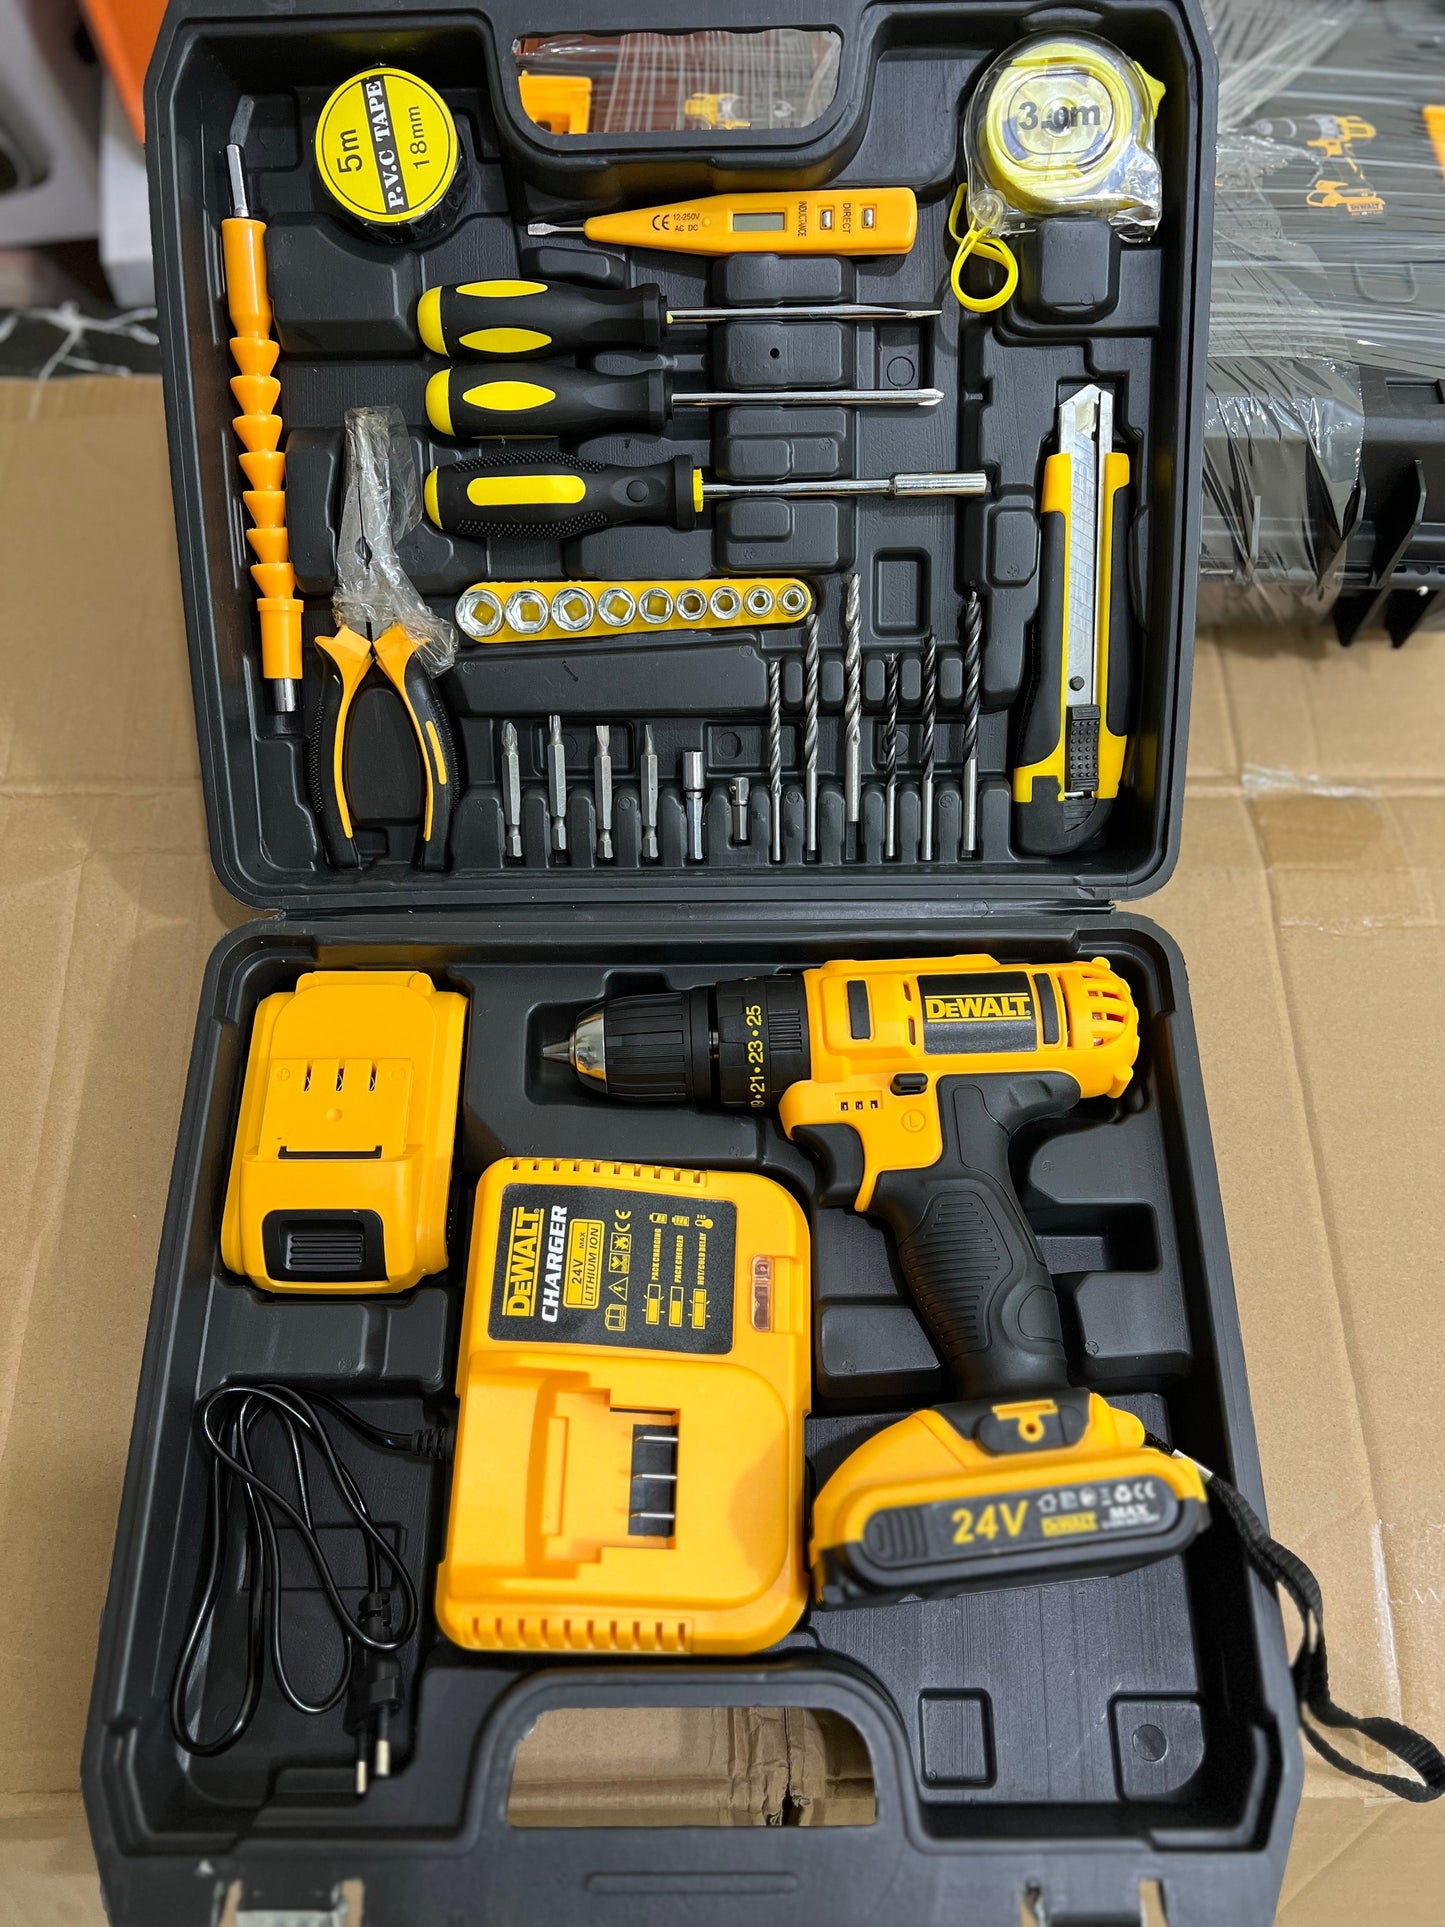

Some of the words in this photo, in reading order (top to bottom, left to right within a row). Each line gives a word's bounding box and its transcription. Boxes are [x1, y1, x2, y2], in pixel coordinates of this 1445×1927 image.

[365, 80, 391, 142] TAPE
[408, 106, 430, 169] 18mm
[336, 129, 363, 174] 5m
[378, 149, 405, 209] P.V.C
[673, 213, 700, 221] 12-250V
[842, 202, 852, 234] DIRECT
[746, 1005, 762, 1026] 25
[748, 1040, 764, 1064] 23
[749, 1075, 765, 1092] 21
[589, 1227, 599, 1251] ION
[698, 1232, 707, 1253] DELAY
[541, 1205, 568, 1323] CHARGER
[572, 1259, 585, 1285] 24V
[652, 1263, 661, 1281] PACK
[674, 1266, 682, 1284] PACK
[584, 1253, 597, 1302] LITHIUM
[952, 1499, 1029, 1545] 24V
